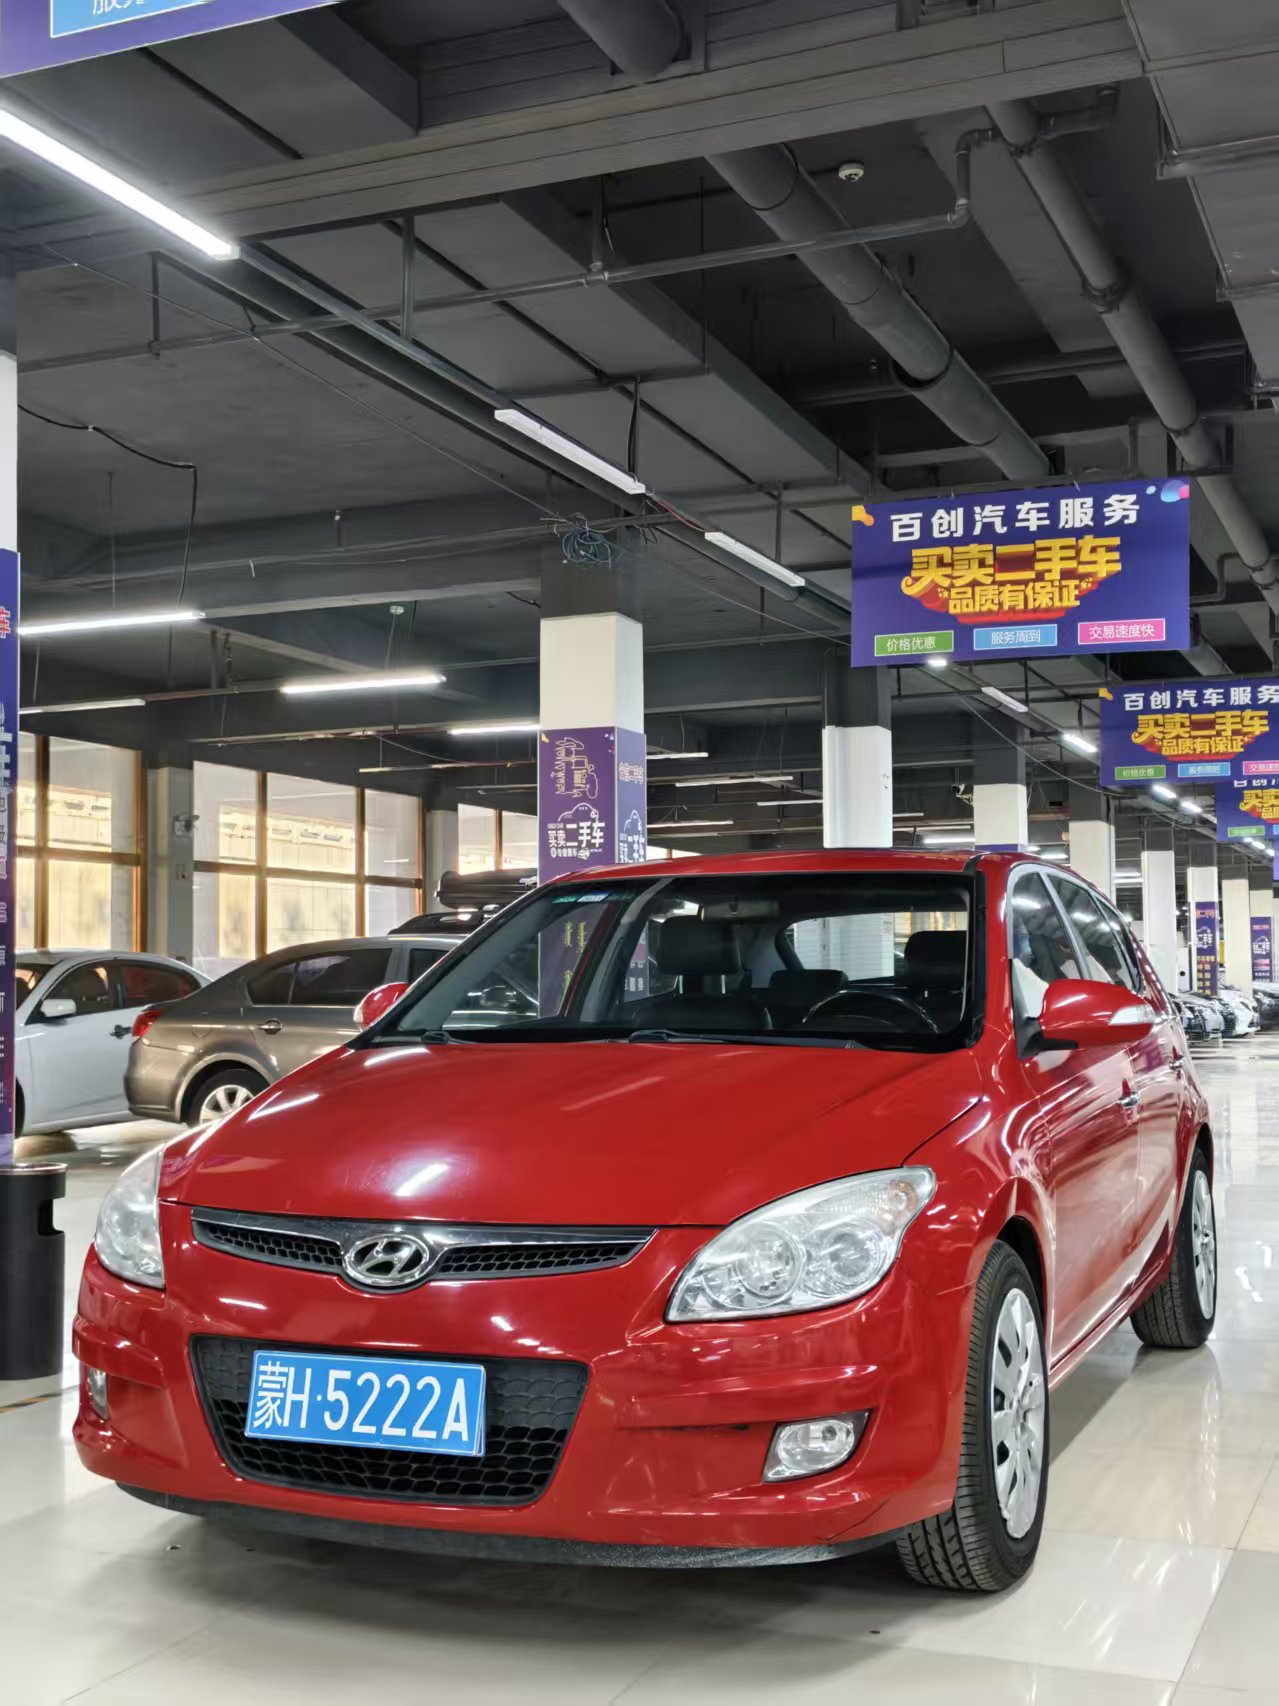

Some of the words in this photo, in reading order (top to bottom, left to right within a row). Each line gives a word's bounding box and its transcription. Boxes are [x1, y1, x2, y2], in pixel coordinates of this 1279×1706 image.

[890, 494, 1140, 542] 百创汽车服务
[902, 535, 1121, 592] 买卖二手车
[948, 579, 1081, 615] 品质有保证
[886, 636, 937, 651] 价格优惠
[991, 629, 1041, 645] 服务周到
[1088, 624, 1155, 640] 交易速度快
[1123, 685, 1279, 711] 百创汽车服务
[1131, 709, 1270, 744] 买卖二手车
[1161, 736, 1245, 756] 品质有保证
[547, 821, 606, 848] 买卖二手车
